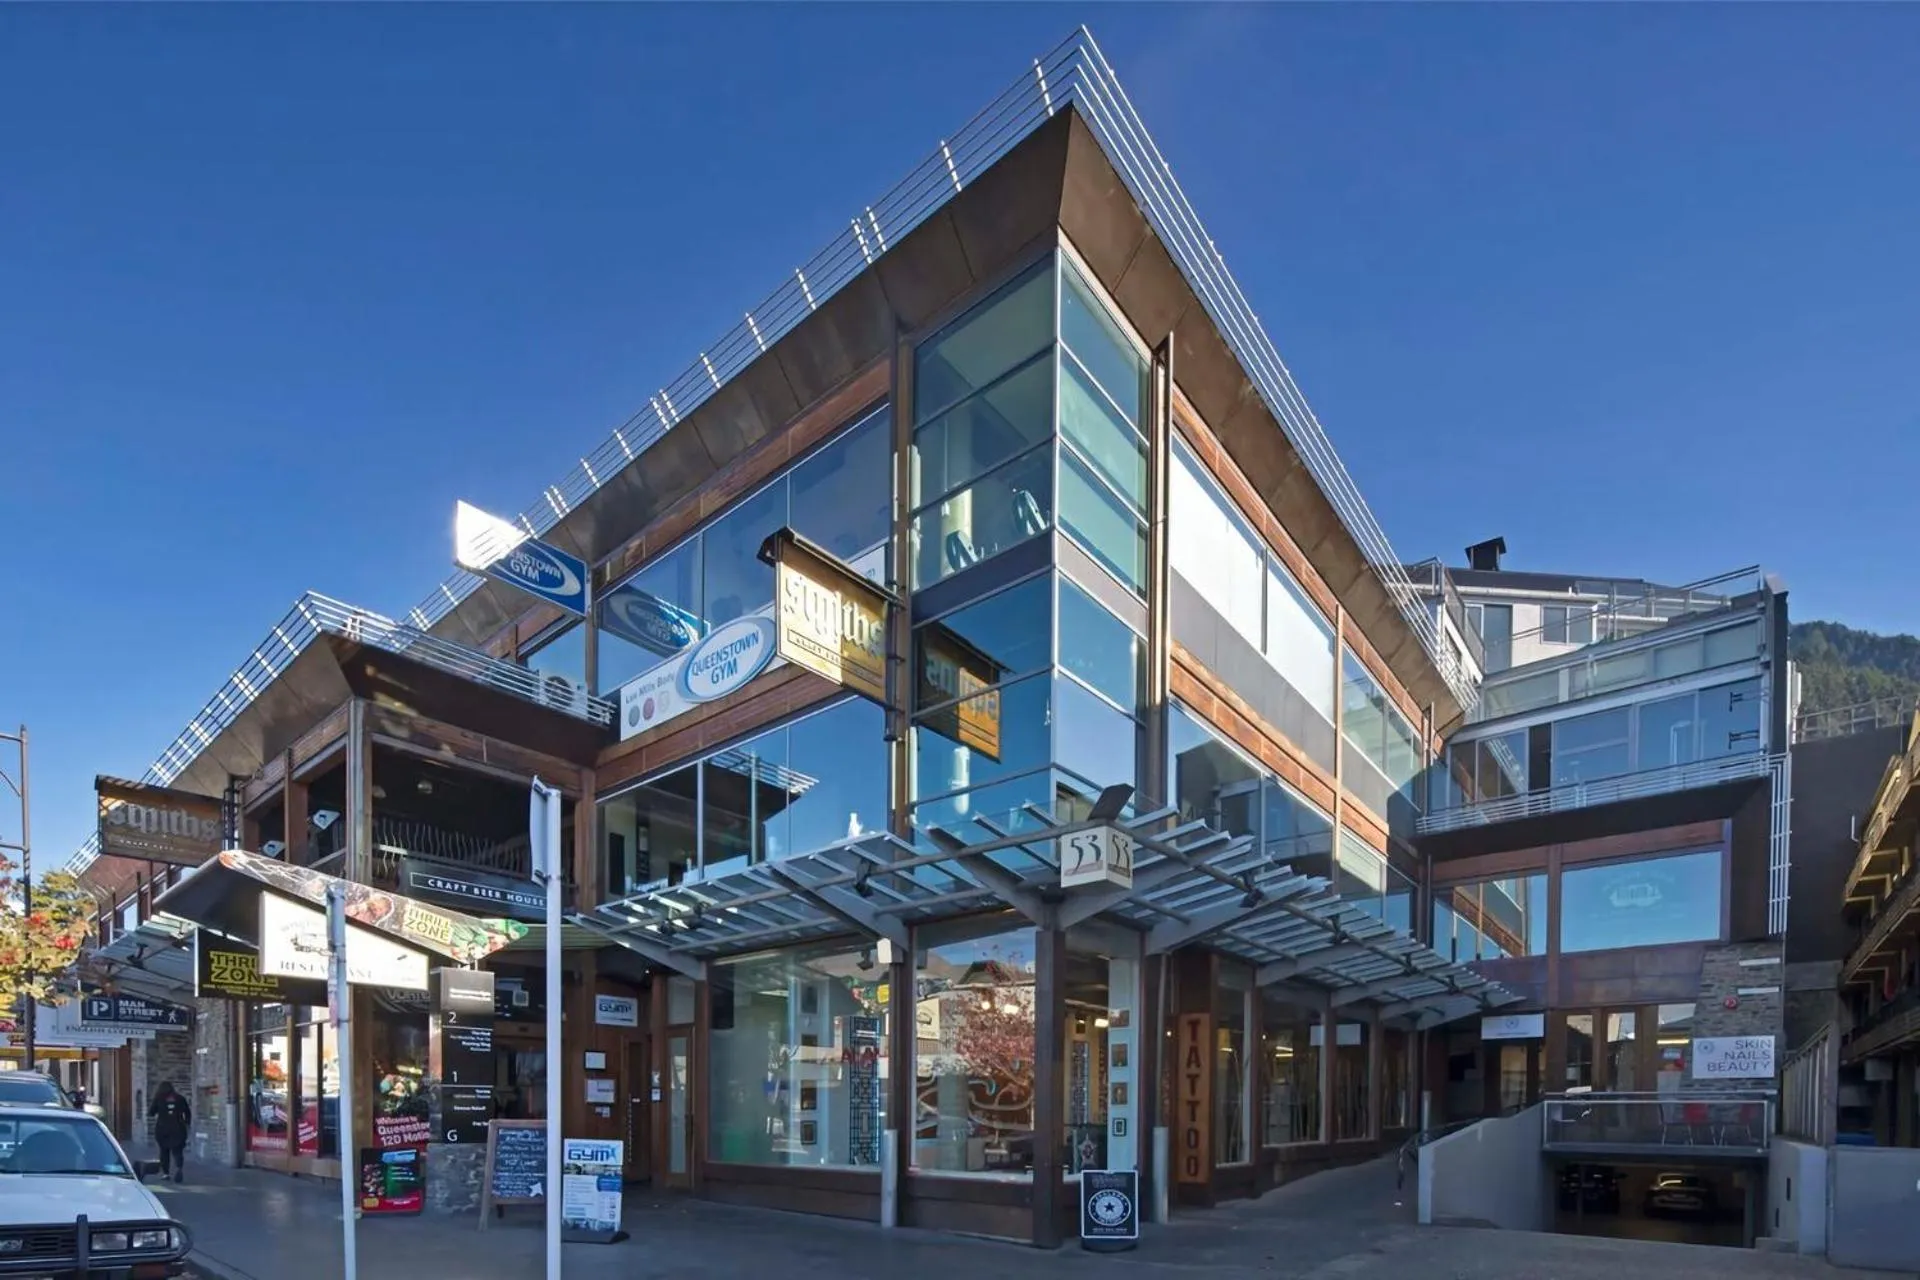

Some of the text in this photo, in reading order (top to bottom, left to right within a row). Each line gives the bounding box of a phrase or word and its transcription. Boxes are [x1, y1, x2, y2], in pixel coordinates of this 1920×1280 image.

[510, 558, 540, 583] GYM
[691, 631, 759, 678] QUEENSTOWN
[711, 657, 738, 686] GYM
[1070, 834, 1102, 875] 53
[1112, 833, 1131, 870] 53
[427, 878, 546, 907] CRAFT BEER HOUSE
[405, 916, 450, 941] ZONE
[408, 907, 450, 931] THRILL
[213, 954, 257, 969] THRI
[118, 1000, 146, 1009] MAN
[118, 1007, 165, 1018] STREET
[448, 1011, 457, 1024] 2
[1735, 1039, 1772, 1050] SKIN
[1724, 1049, 1772, 1061] NAILS
[1707, 1060, 1771, 1073] BEAUTY
[452, 1070, 458, 1083] 1
[1186, 1018, 1201, 1178] TATTOO
[447, 1129, 458, 1142] G
